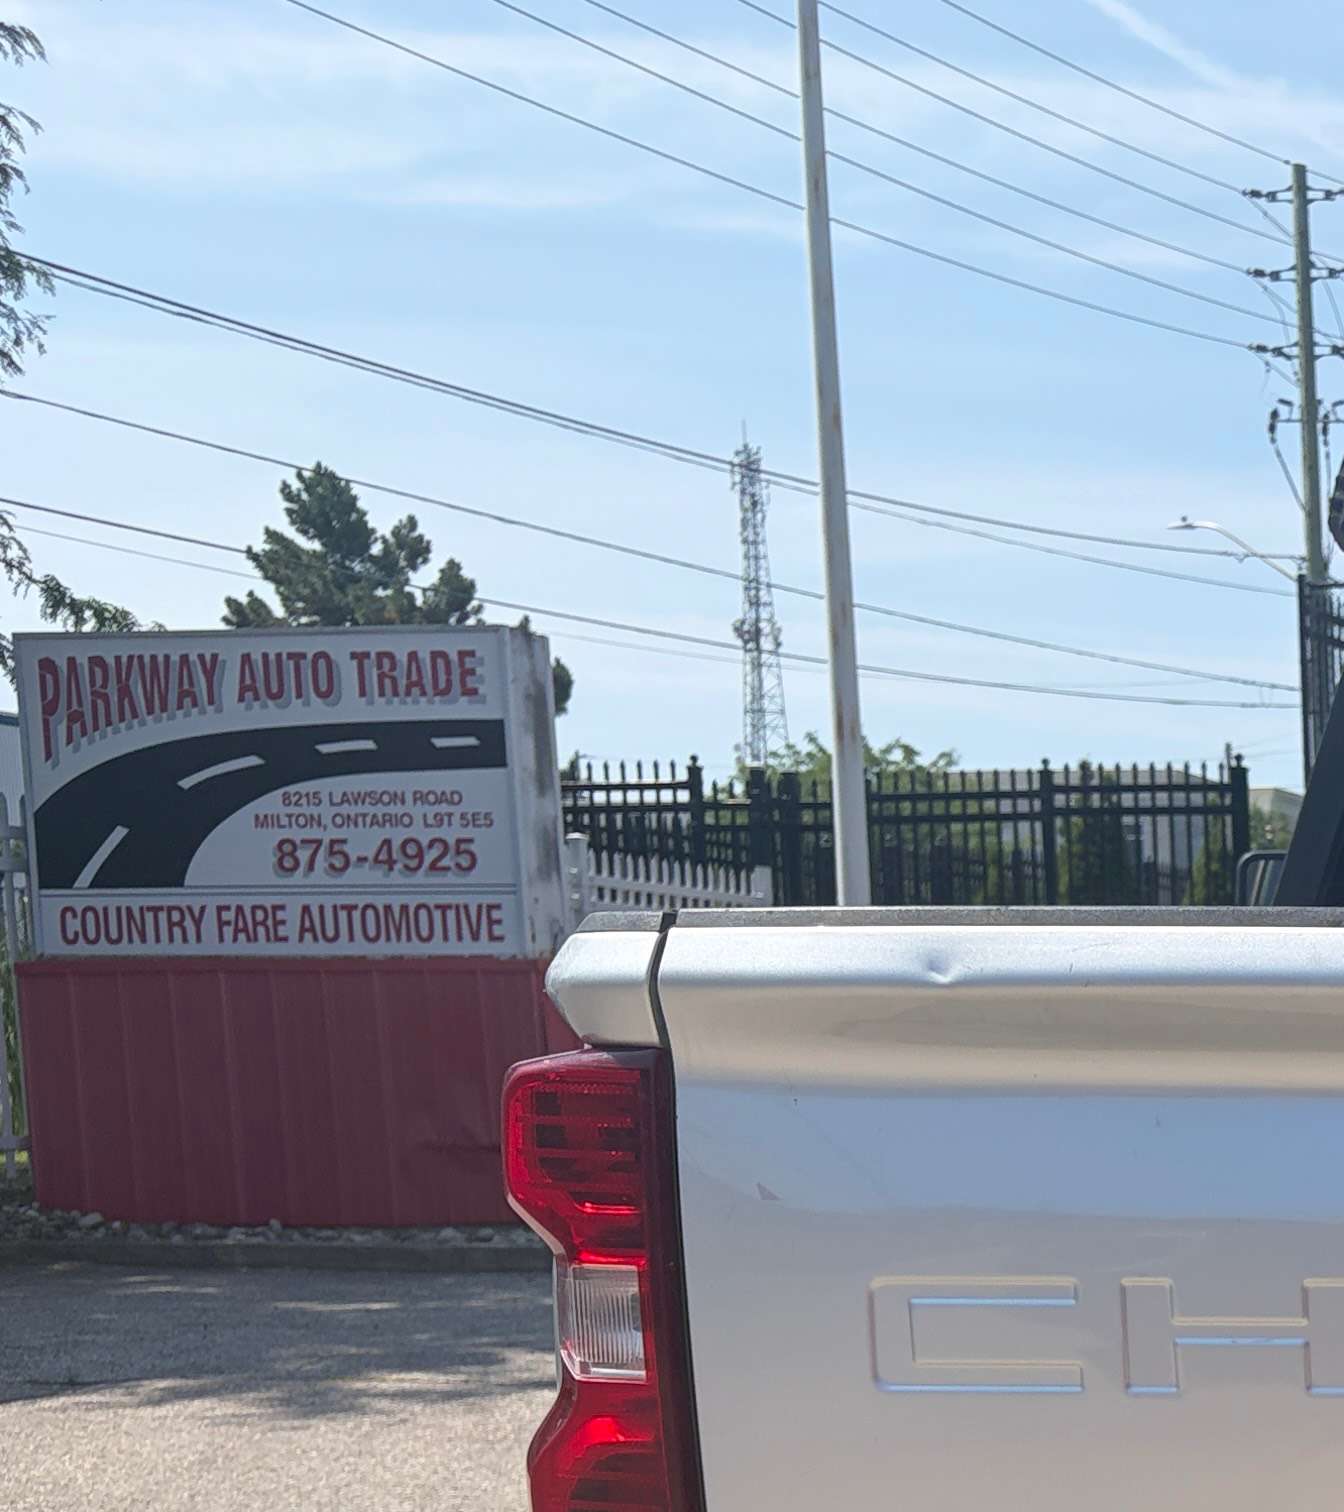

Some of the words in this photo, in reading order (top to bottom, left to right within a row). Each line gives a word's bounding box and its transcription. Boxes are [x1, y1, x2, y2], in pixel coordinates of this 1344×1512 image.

[37, 653, 219, 763] PARKWAY
[237, 650, 335, 703] AUTO
[350, 648, 481, 699] TRADE
[282, 790, 324, 807] 8215
[328, 790, 407, 807] LAWSON
[412, 790, 464, 807] ROAD
[254, 813, 329, 831] MILTON,
[331, 812, 415, 829] ONTARIO
[423, 812, 456, 829] L9T
[460, 813, 494, 829] 5E5
[273, 837, 478, 873] 875-4925
[60, 905, 207, 946] COUNTRY
[216, 905, 290, 943] FARE
[297, 903, 505, 945] AUTOMOTIVE
